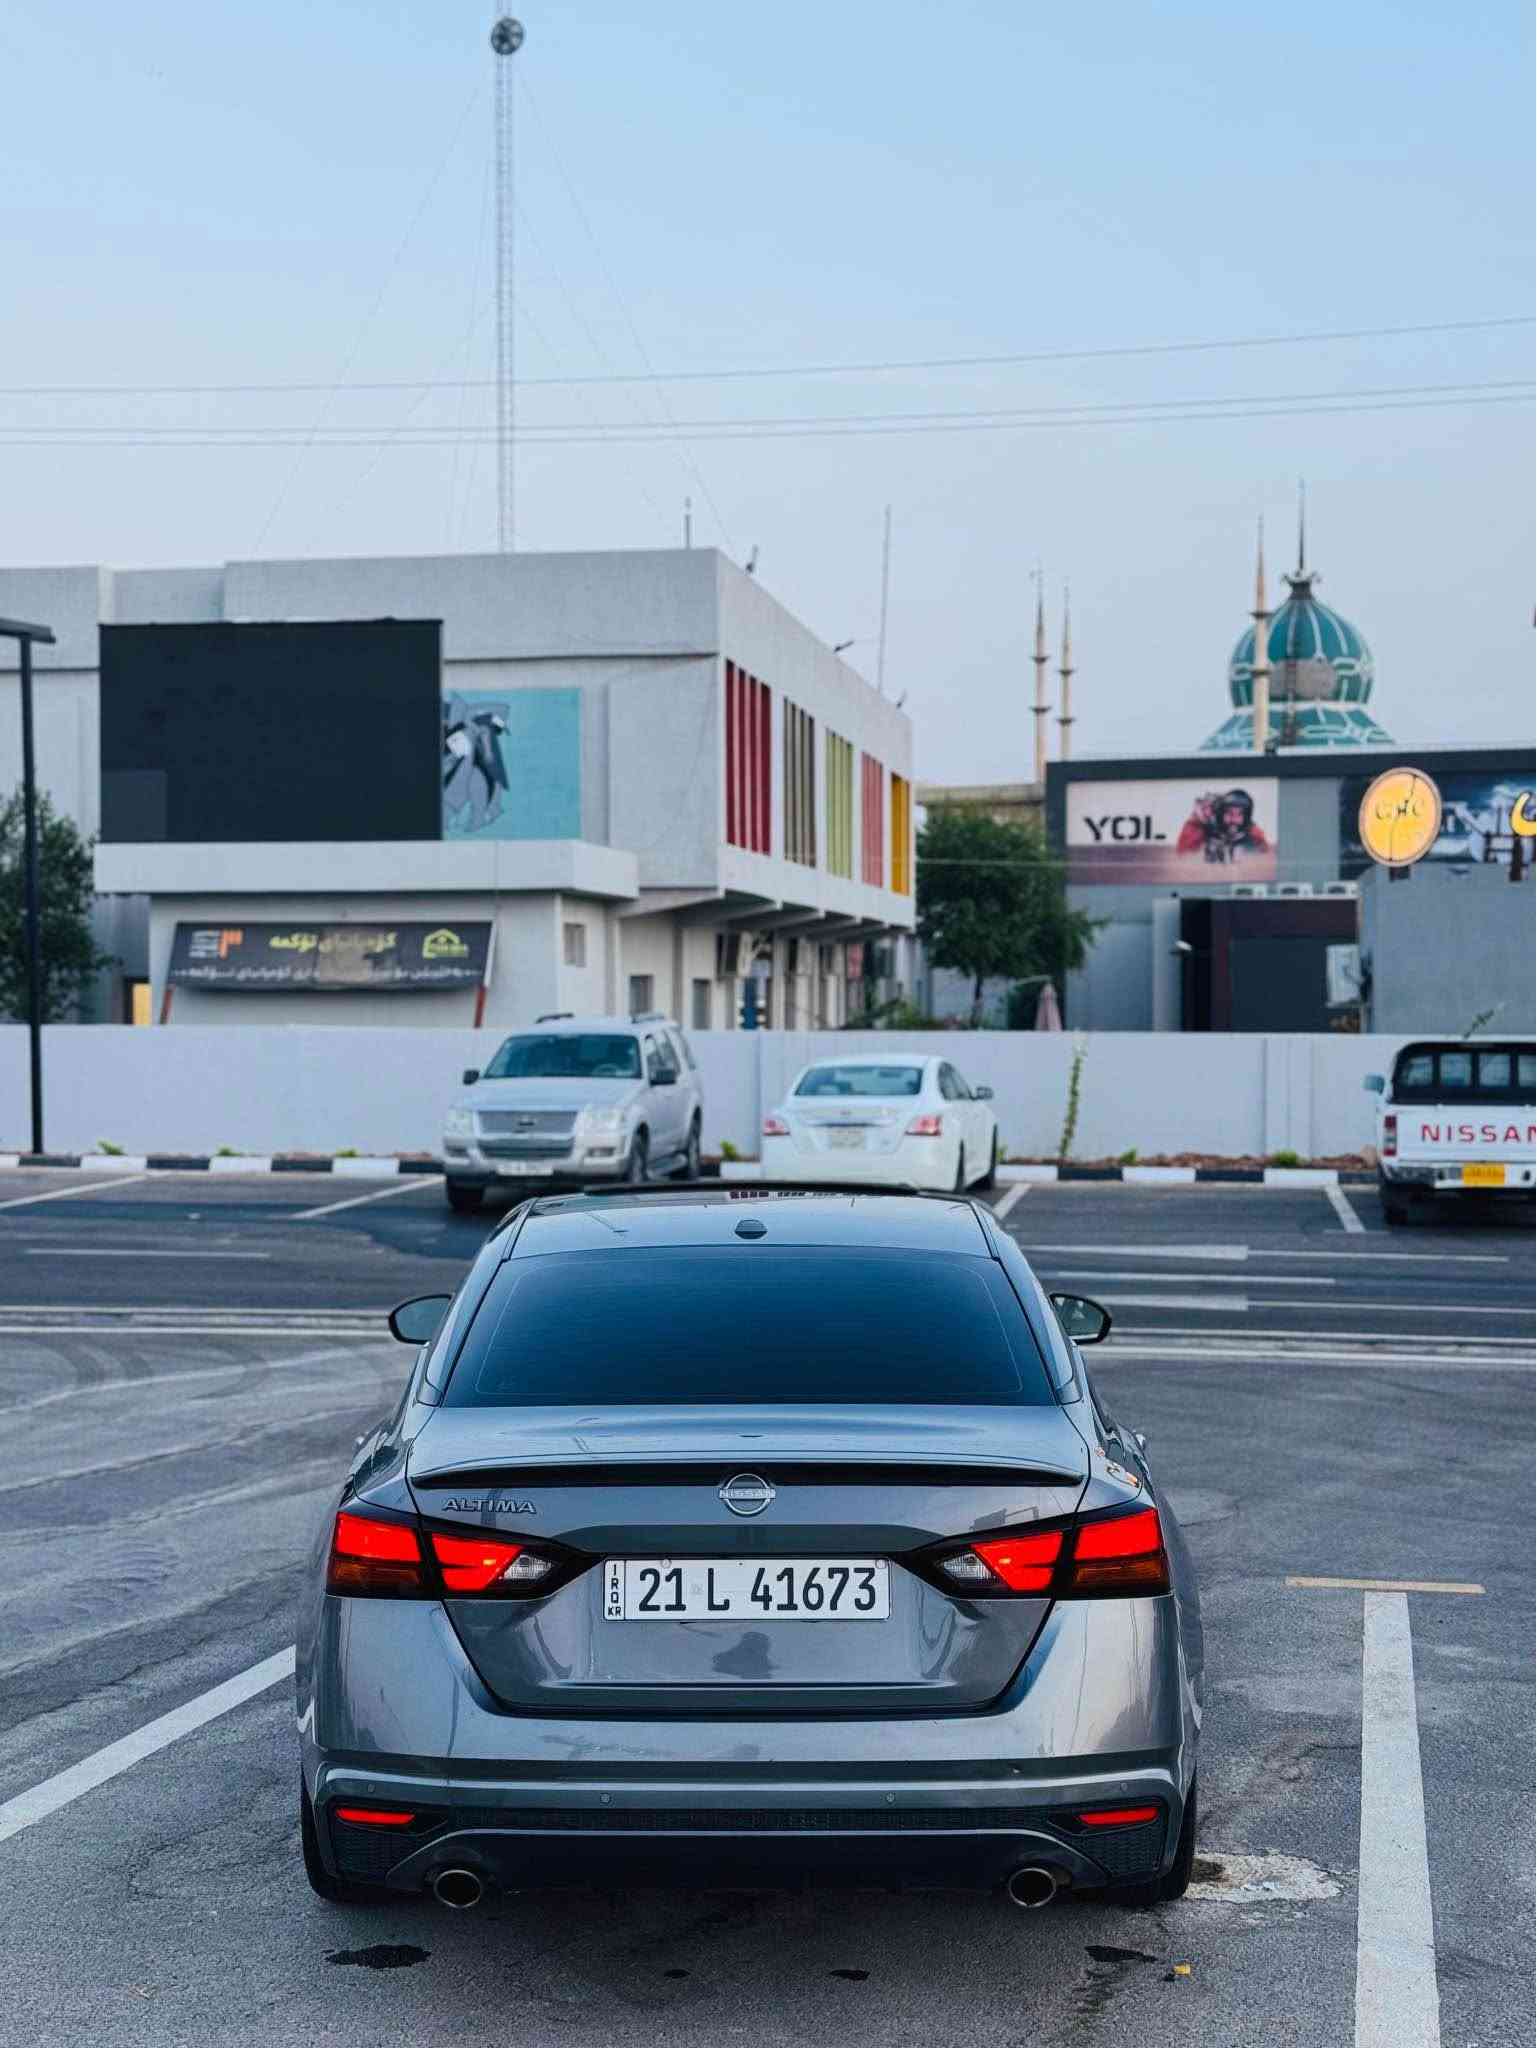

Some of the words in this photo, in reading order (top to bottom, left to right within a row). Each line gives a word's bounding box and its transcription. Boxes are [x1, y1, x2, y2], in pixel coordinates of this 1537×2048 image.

[1083, 815, 1167, 841] YOL
[441, 1497, 537, 1514] ALTIMA
[638, 1567, 687, 1612] 21
[707, 1567, 730, 1611] L
[750, 1567, 876, 1611] 41673
[607, 1606, 622, 1617] KR
